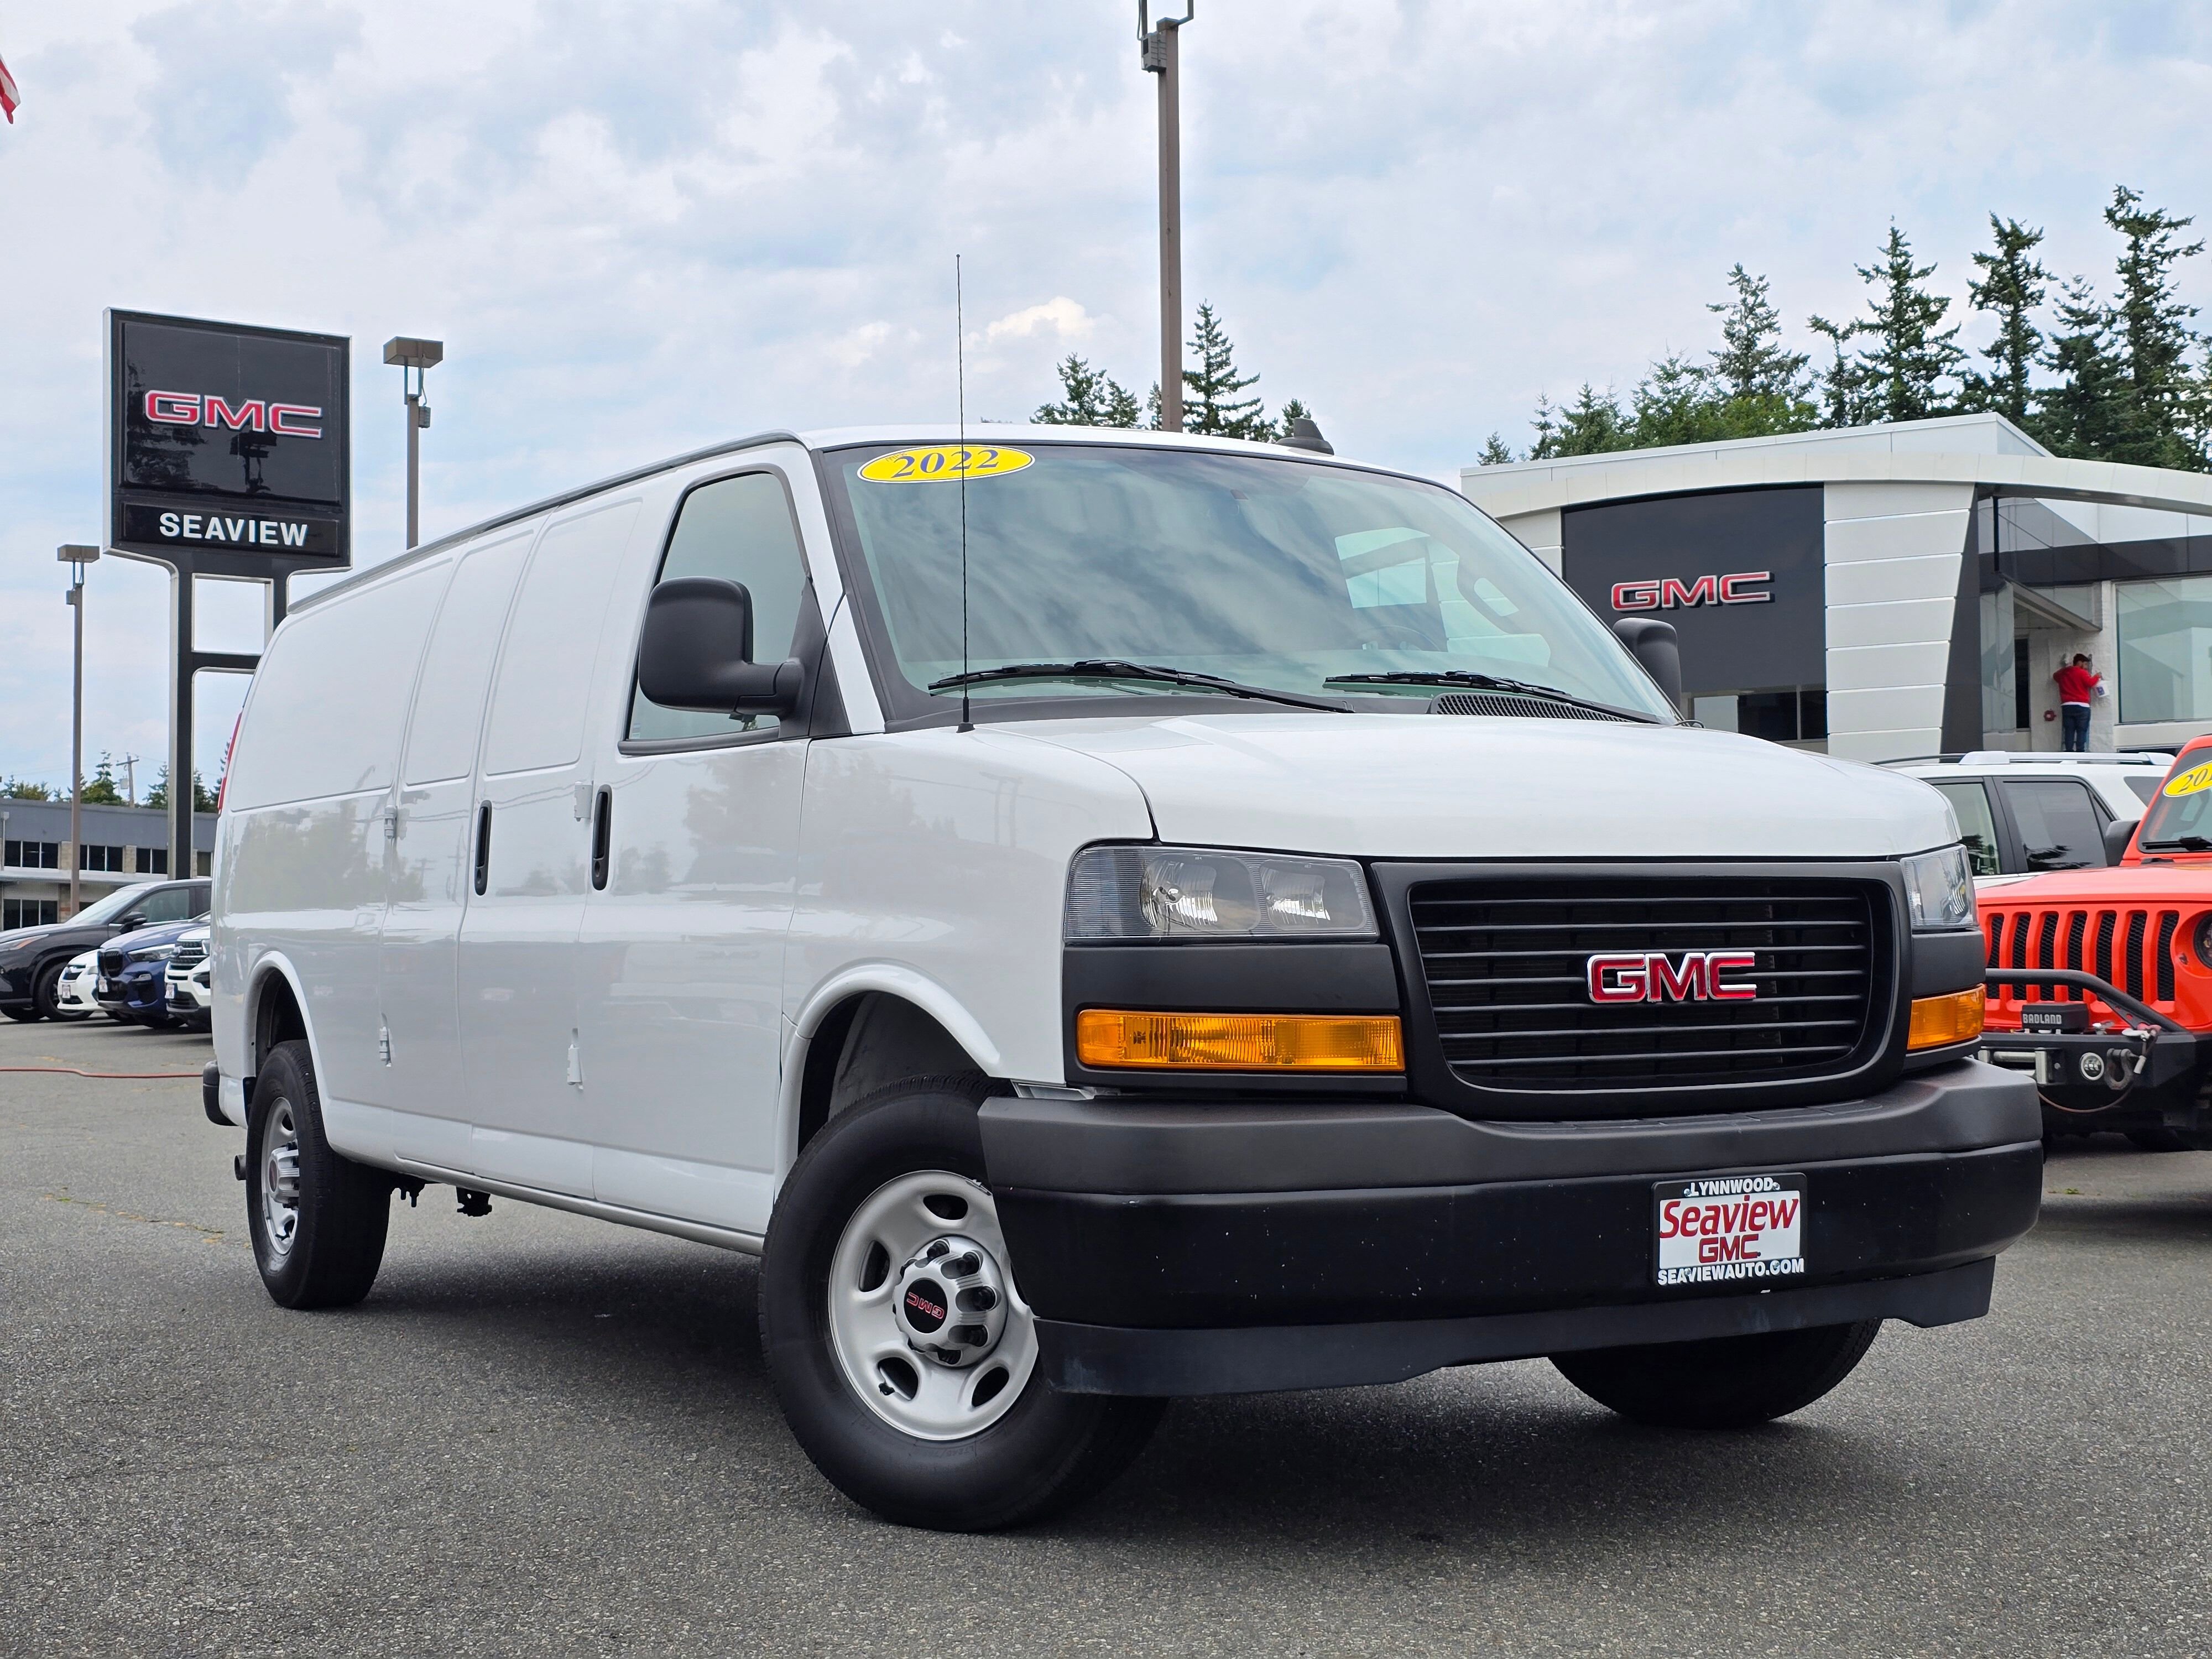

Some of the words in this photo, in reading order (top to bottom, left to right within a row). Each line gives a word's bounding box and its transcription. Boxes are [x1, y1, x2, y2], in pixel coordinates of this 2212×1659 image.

[145, 390, 322, 438] GMC
[891, 450, 999, 478] 2022
[159, 513, 307, 546] SEAVIEW
[1611, 572, 1771, 611] GMC
[2177, 769, 2212, 793] 20
[1588, 952, 1757, 1003] GMC
[2022, 1014, 2062, 1024] BADLAND
[1691, 1177, 1773, 1196] LYNNWOOD
[1660, 1196, 1799, 1238] Seaview
[1699, 1234, 1760, 1263] GMC
[1658, 1259, 1804, 1285] SEAVIEWAUTO.COM
[906, 1291, 945, 1319] GMC
